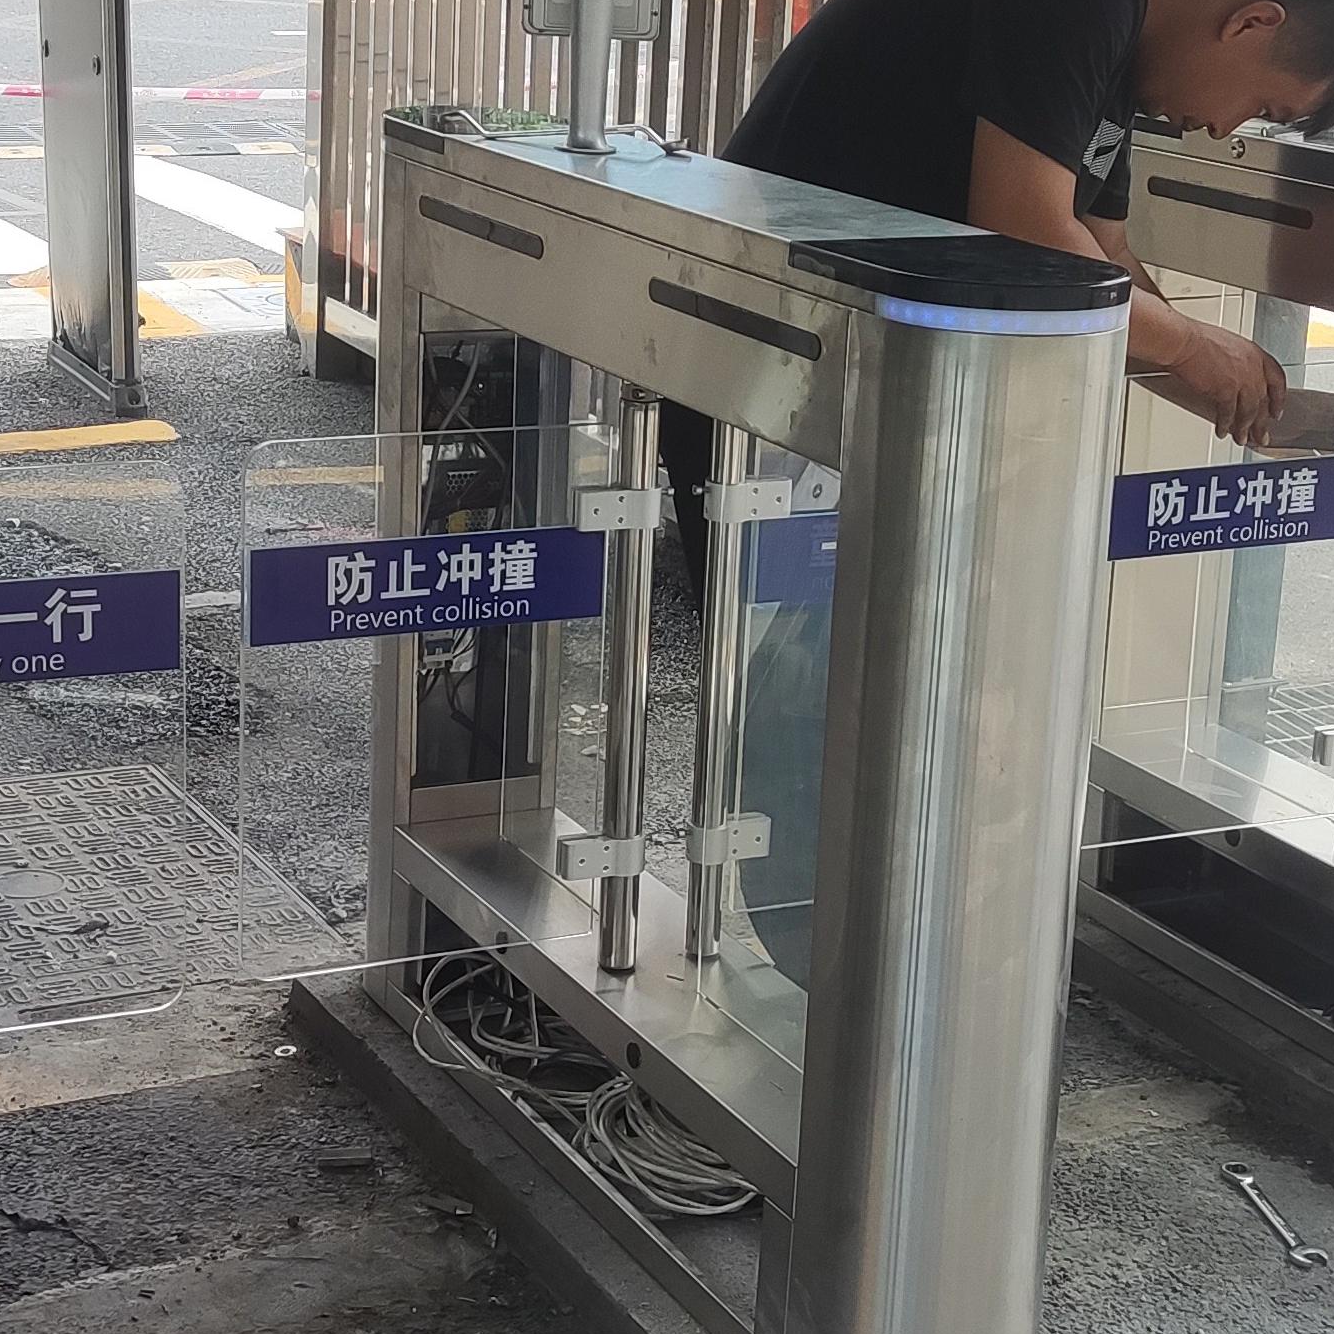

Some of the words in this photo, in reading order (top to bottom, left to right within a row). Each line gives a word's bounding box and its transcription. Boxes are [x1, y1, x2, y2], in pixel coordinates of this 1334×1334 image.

[1146, 467, 1319, 527] 防止冲撞
[1148, 525, 1223, 551] Prevent
[1229, 517, 1309, 542] collision
[326, 539, 538, 607] 防止冲撞
[329, 604, 424, 633] Prevent
[431, 596, 530, 622] collision
[11, 653, 65, 675] one
